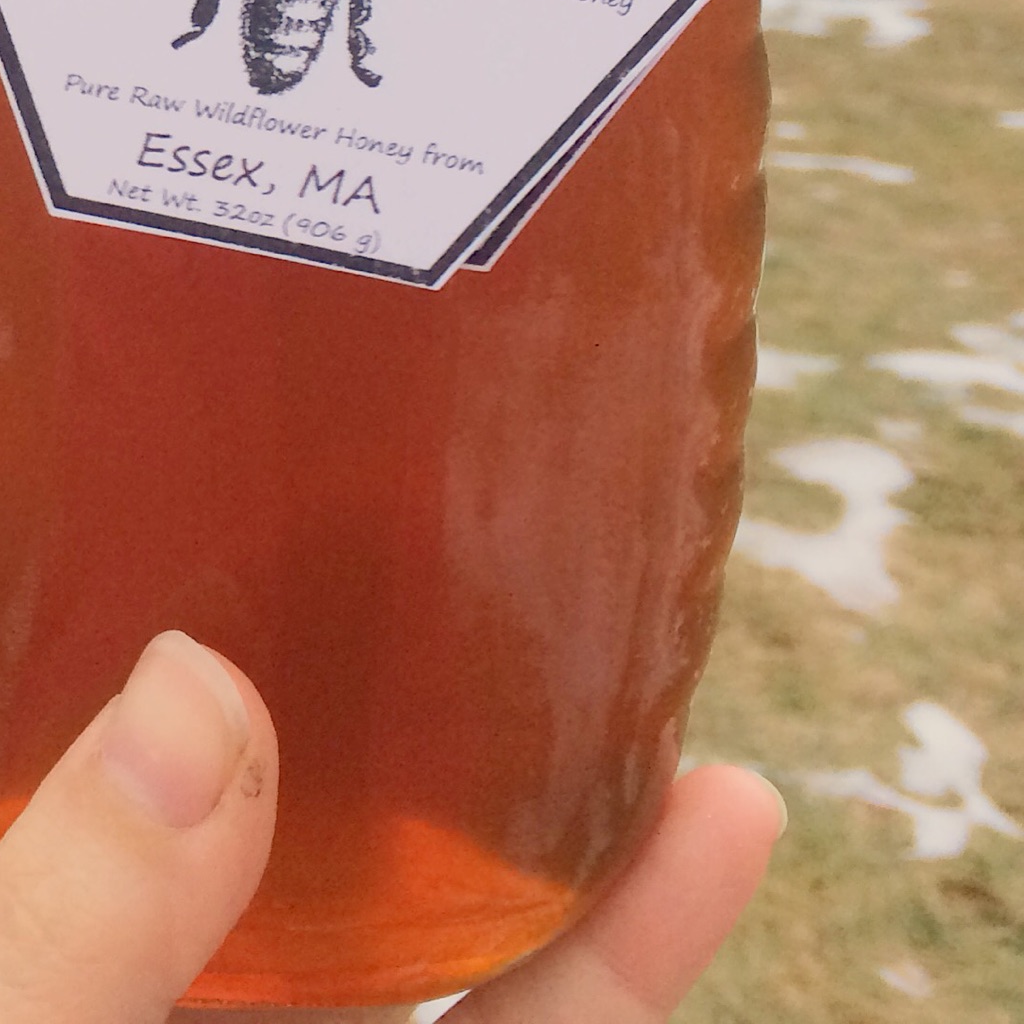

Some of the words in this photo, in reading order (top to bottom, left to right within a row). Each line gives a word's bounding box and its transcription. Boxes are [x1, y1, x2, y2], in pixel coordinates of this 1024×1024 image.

[63, 74, 120, 102] Pure
[129, 86, 186, 114] Raw
[194, 99, 327, 141] Wildflower
[334, 127, 413, 165] Honey
[421, 142, 485, 175] from
[136, 132, 275, 195] Essex,
[297, 164, 380, 214] MA
[107, 178, 154, 203] Net
[162, 189, 201, 213] Wt.
[213, 199, 275, 228] 32oz
[282, 212, 346, 242] (906
[355, 230, 382, 255] g)
